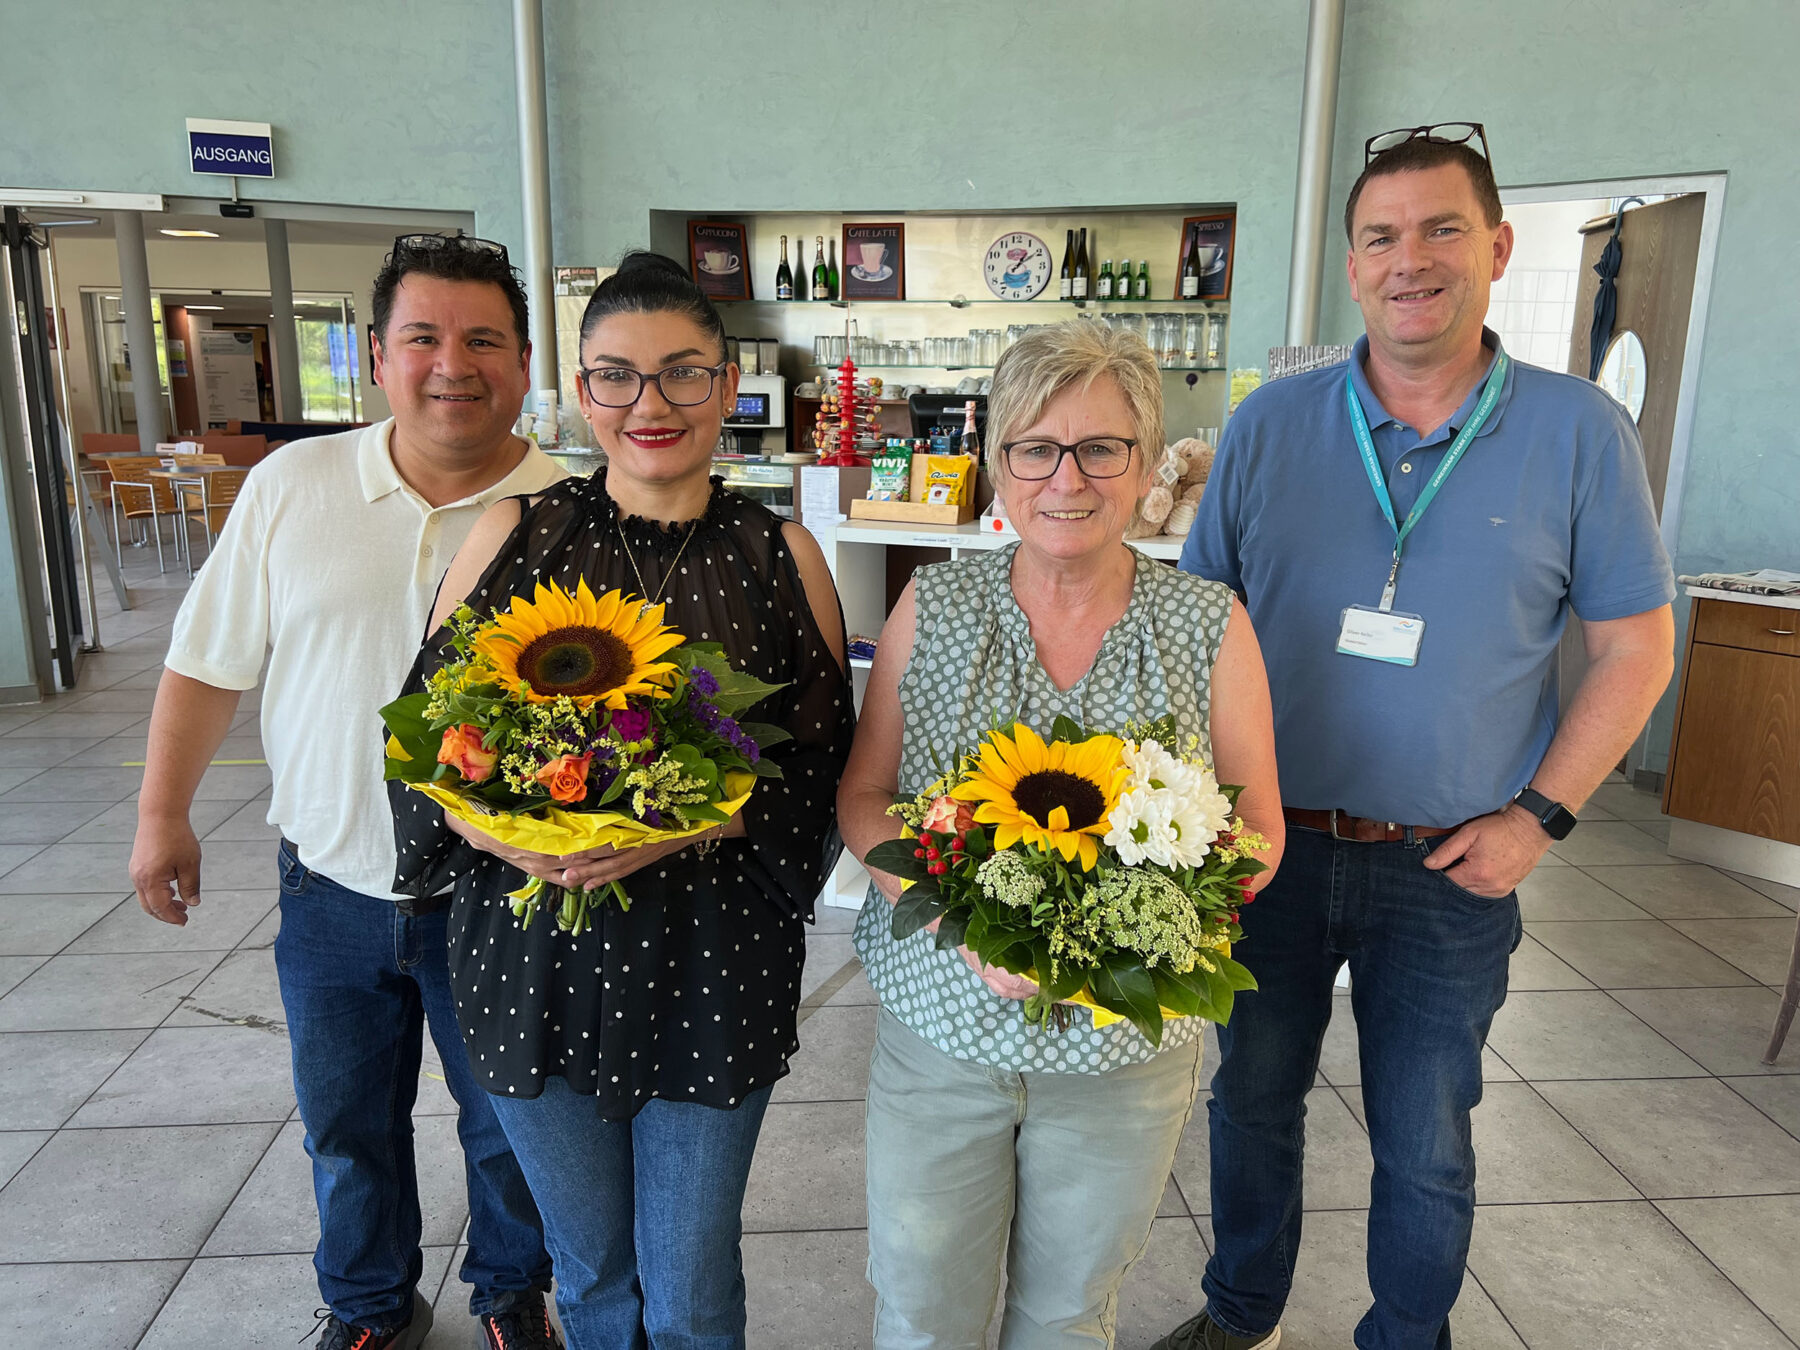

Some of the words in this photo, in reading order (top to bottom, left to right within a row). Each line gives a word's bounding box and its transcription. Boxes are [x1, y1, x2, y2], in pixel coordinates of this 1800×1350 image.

[194, 146, 270, 164] AUSGANG
[872, 229, 897, 238] LATTE
[1011, 235, 1023, 244] 12
[1000, 240, 1008, 249] 11
[989, 251, 1000, 259] 10
[1036, 248, 1043, 257] 2
[987, 264, 995, 272] 9
[1039, 261, 1046, 270] 3
[991, 276, 998, 285] 8
[1000, 286, 1007, 295] 7
[1026, 285, 1033, 294] 5
[1013, 291, 1020, 299] 6
[1432, 455, 1455, 488] GEMEINSAM
[1453, 438, 1466, 456] STARK
[1464, 428, 1473, 440] FÜR
[1471, 415, 1481, 429] IHRE
[872, 457, 909, 470] VIVIL
